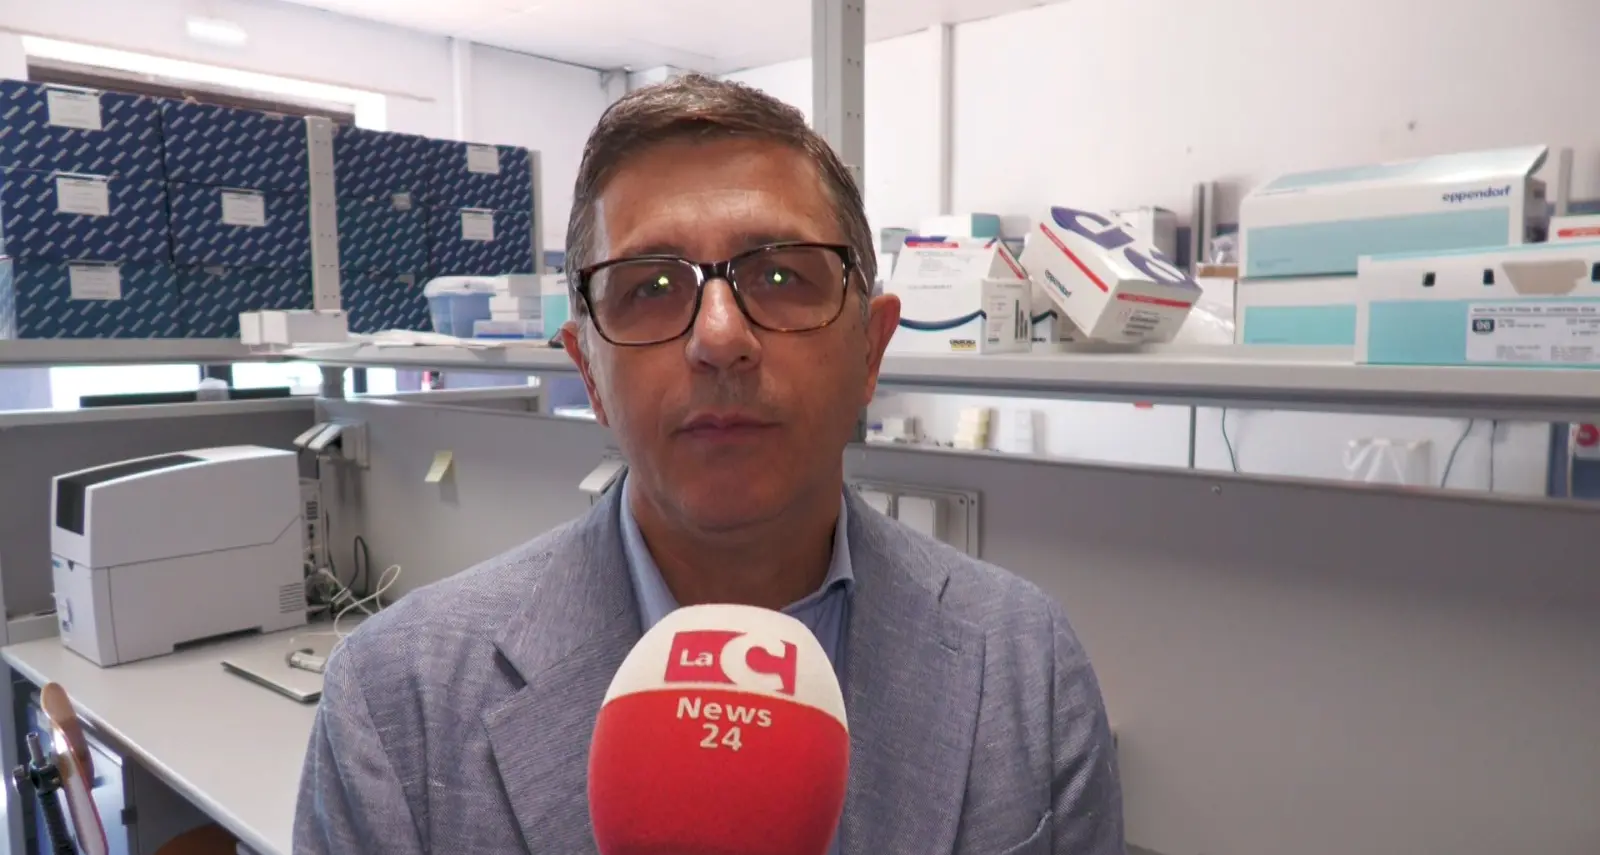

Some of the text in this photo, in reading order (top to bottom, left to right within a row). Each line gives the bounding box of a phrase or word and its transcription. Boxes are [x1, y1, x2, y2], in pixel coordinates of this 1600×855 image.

[1442, 185, 1511, 202] eppendorf
[679, 648, 714, 667] La
[676, 696, 772, 728] News
[700, 723, 742, 751] 24
